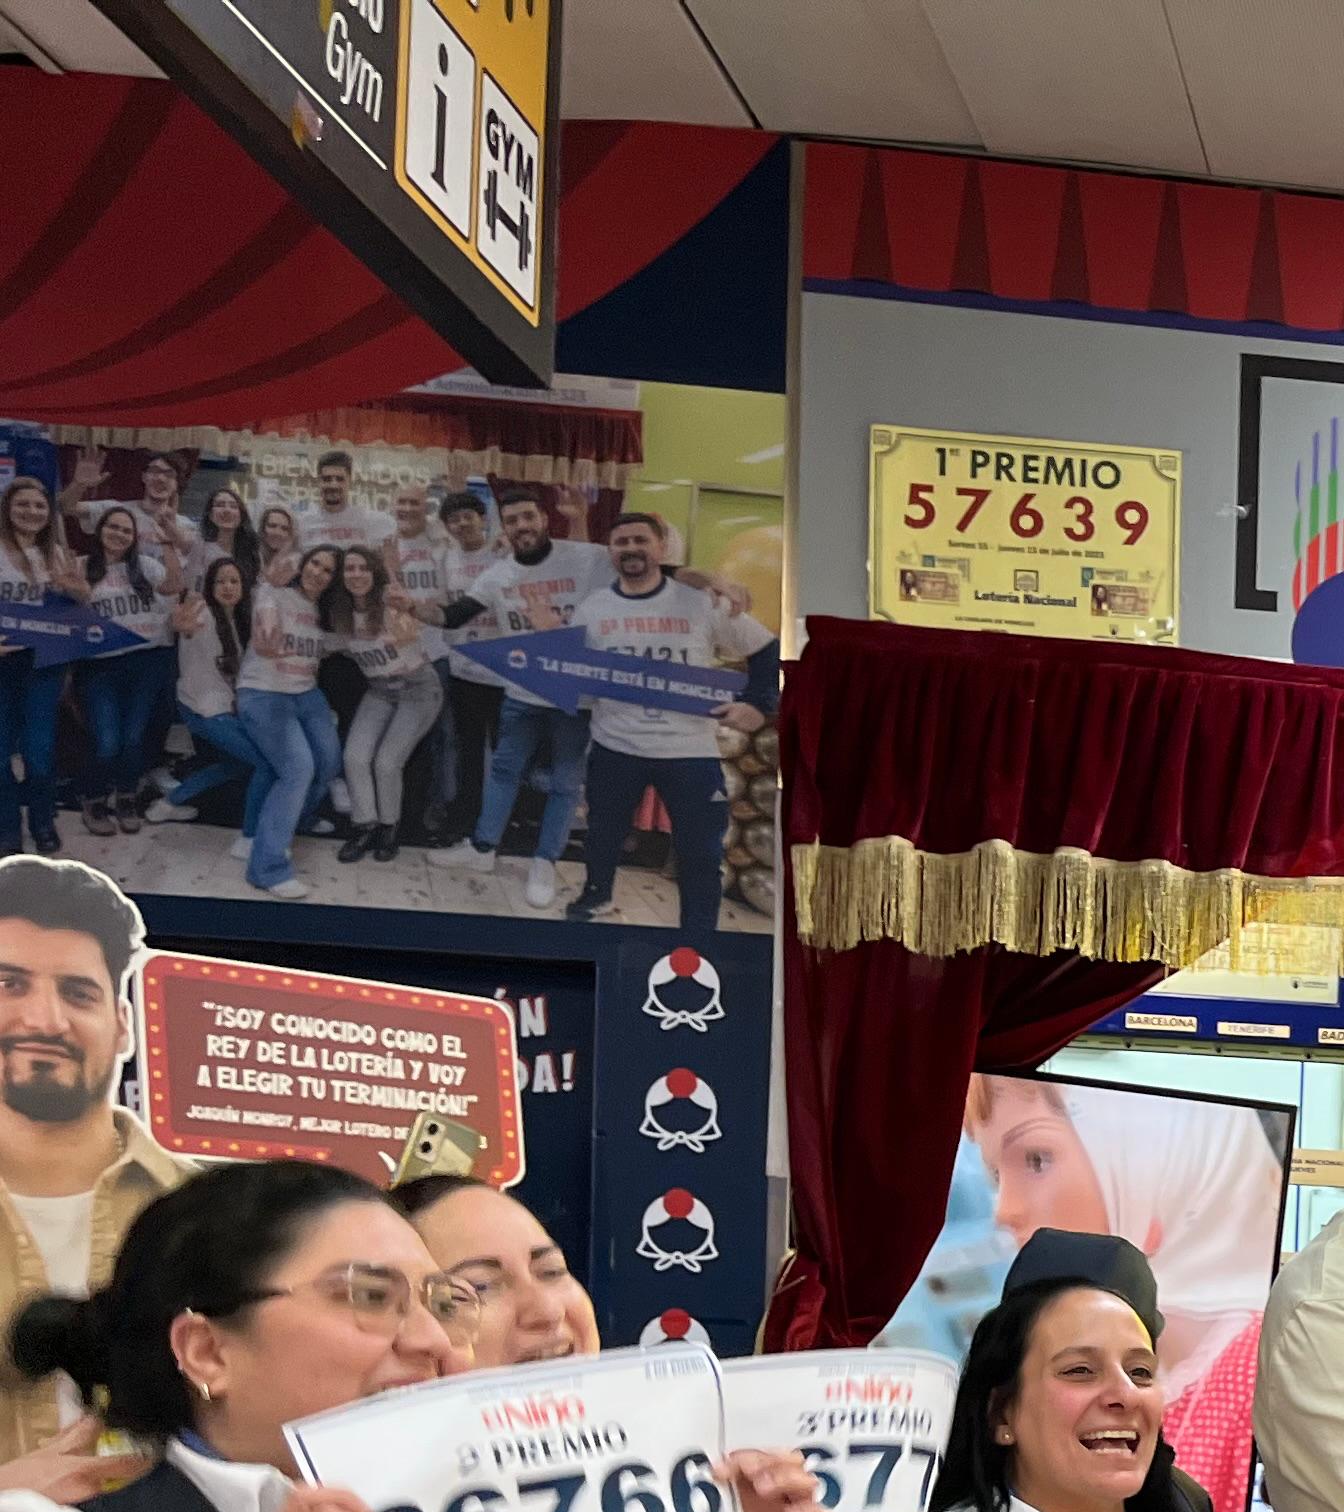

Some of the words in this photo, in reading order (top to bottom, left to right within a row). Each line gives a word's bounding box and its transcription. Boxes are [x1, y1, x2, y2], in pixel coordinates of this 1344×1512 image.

[326, 12, 383, 123] Gym
[486, 108, 534, 202] GYM
[969, 449, 1121, 490] PREMIO
[903, 482, 1150, 546] 57639
[270, 1011, 376, 1046] CONOCIDO
[380, 1026, 438, 1055] COMO
[442, 1035, 468, 1059] EL
[1127, 1013, 1196, 1028] BARCELONA
[1227, 1023, 1276, 1035] TENERIFE
[196, 1064, 212, 1088] A
[216, 1066, 293, 1097] ELEGIR
[296, 1075, 327, 1101] TU
[206, 1033, 251, 1060] REY
[256, 1042, 287, 1066] DE
[290, 1043, 318, 1069] LA
[321, 1049, 405, 1081] LOTERÍA
[408, 1060, 423, 1082] Y
[429, 1063, 466, 1087] VOY
[492, 1420, 630, 1471] PREMIO
